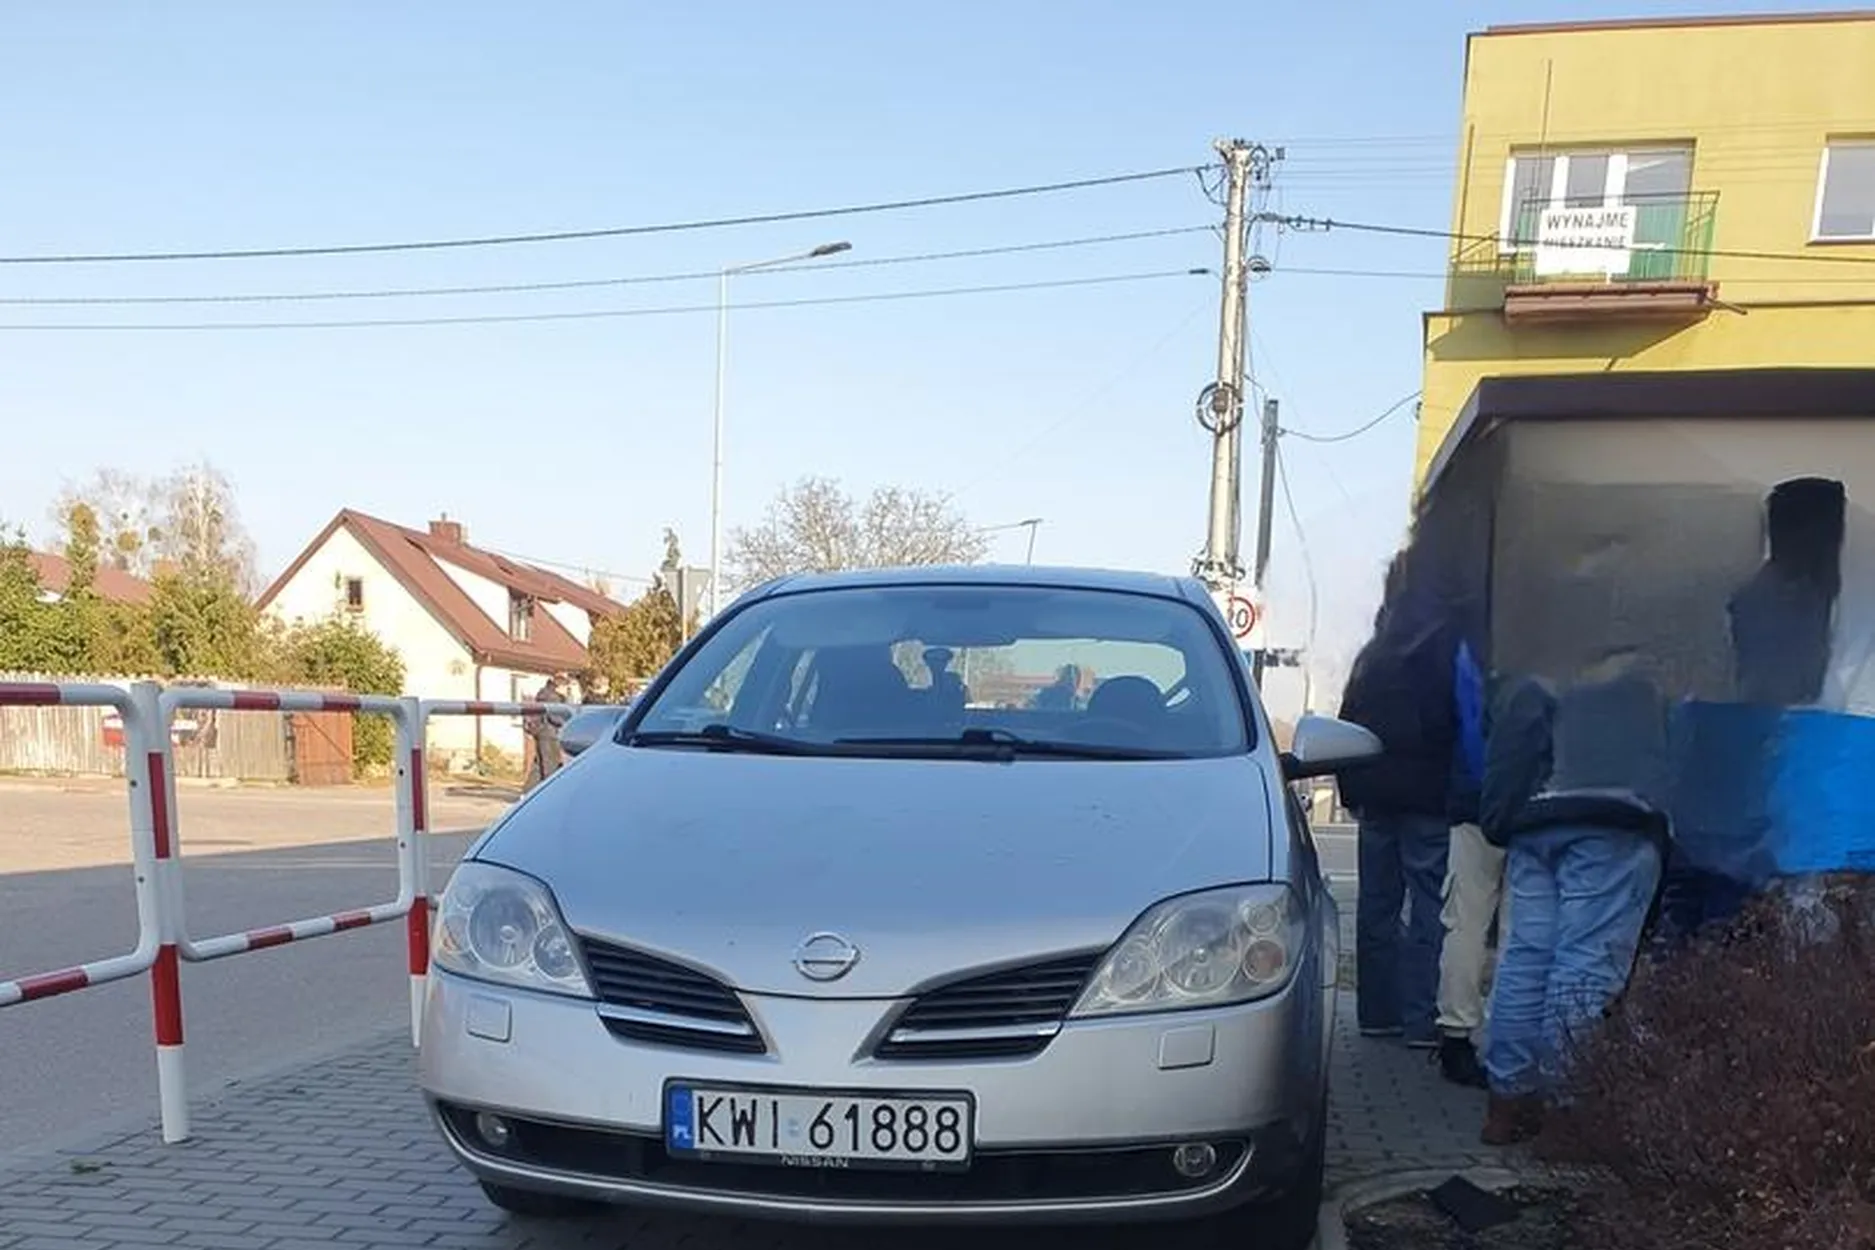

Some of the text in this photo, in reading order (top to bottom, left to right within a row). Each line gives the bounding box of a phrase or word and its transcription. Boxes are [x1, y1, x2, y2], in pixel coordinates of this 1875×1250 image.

[698, 1096, 779, 1149] KWI
[809, 1102, 961, 1152] 61888
[781, 1155, 849, 1168] NISSAN
